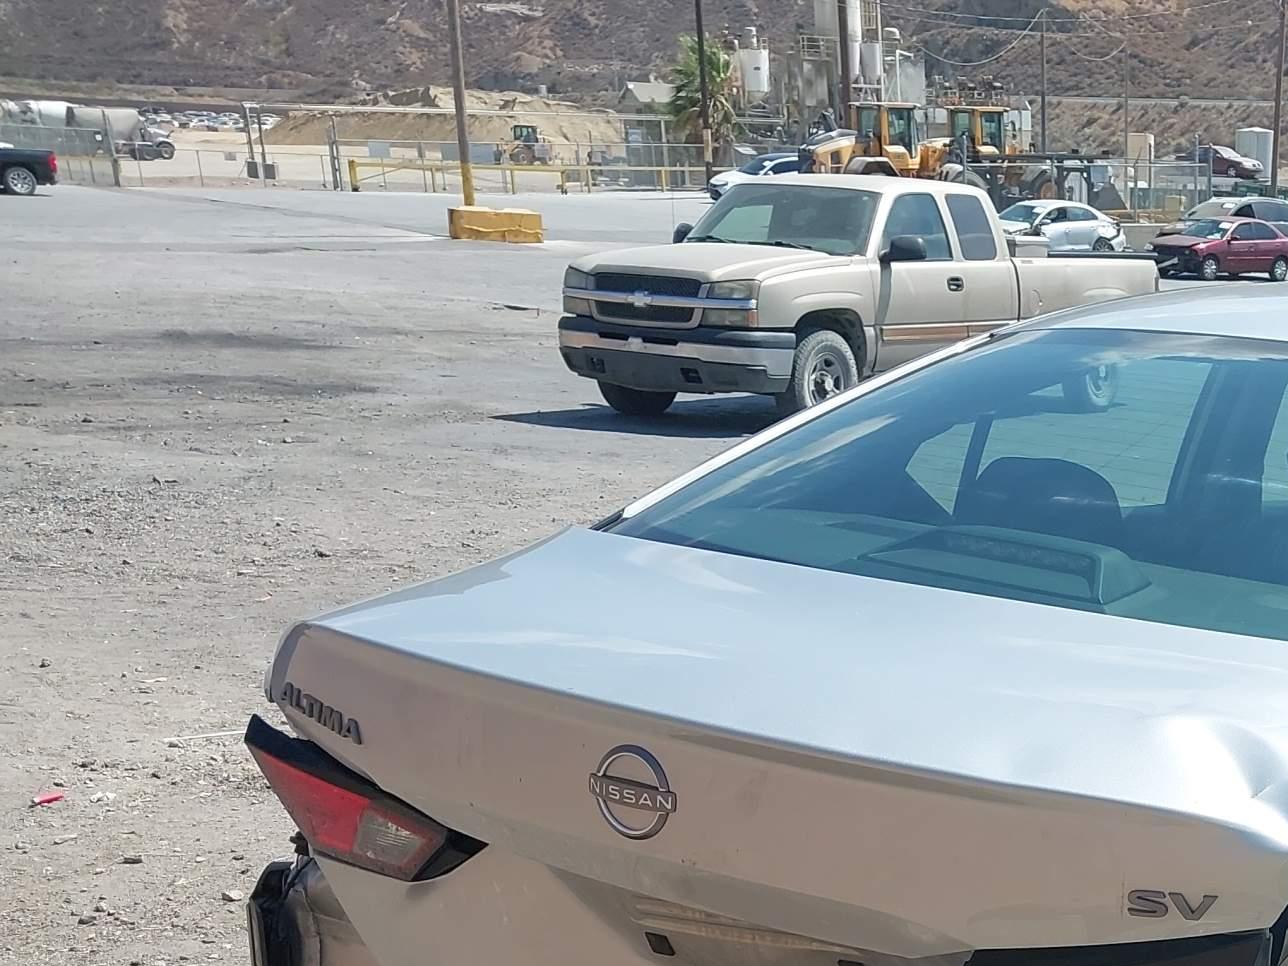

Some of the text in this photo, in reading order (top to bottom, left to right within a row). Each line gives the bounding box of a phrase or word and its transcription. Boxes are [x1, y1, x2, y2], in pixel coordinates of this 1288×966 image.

[281, 681, 363, 745] ALTIMA
[589, 777, 673, 811] NISSAN
[1127, 889, 1219, 922] SV
